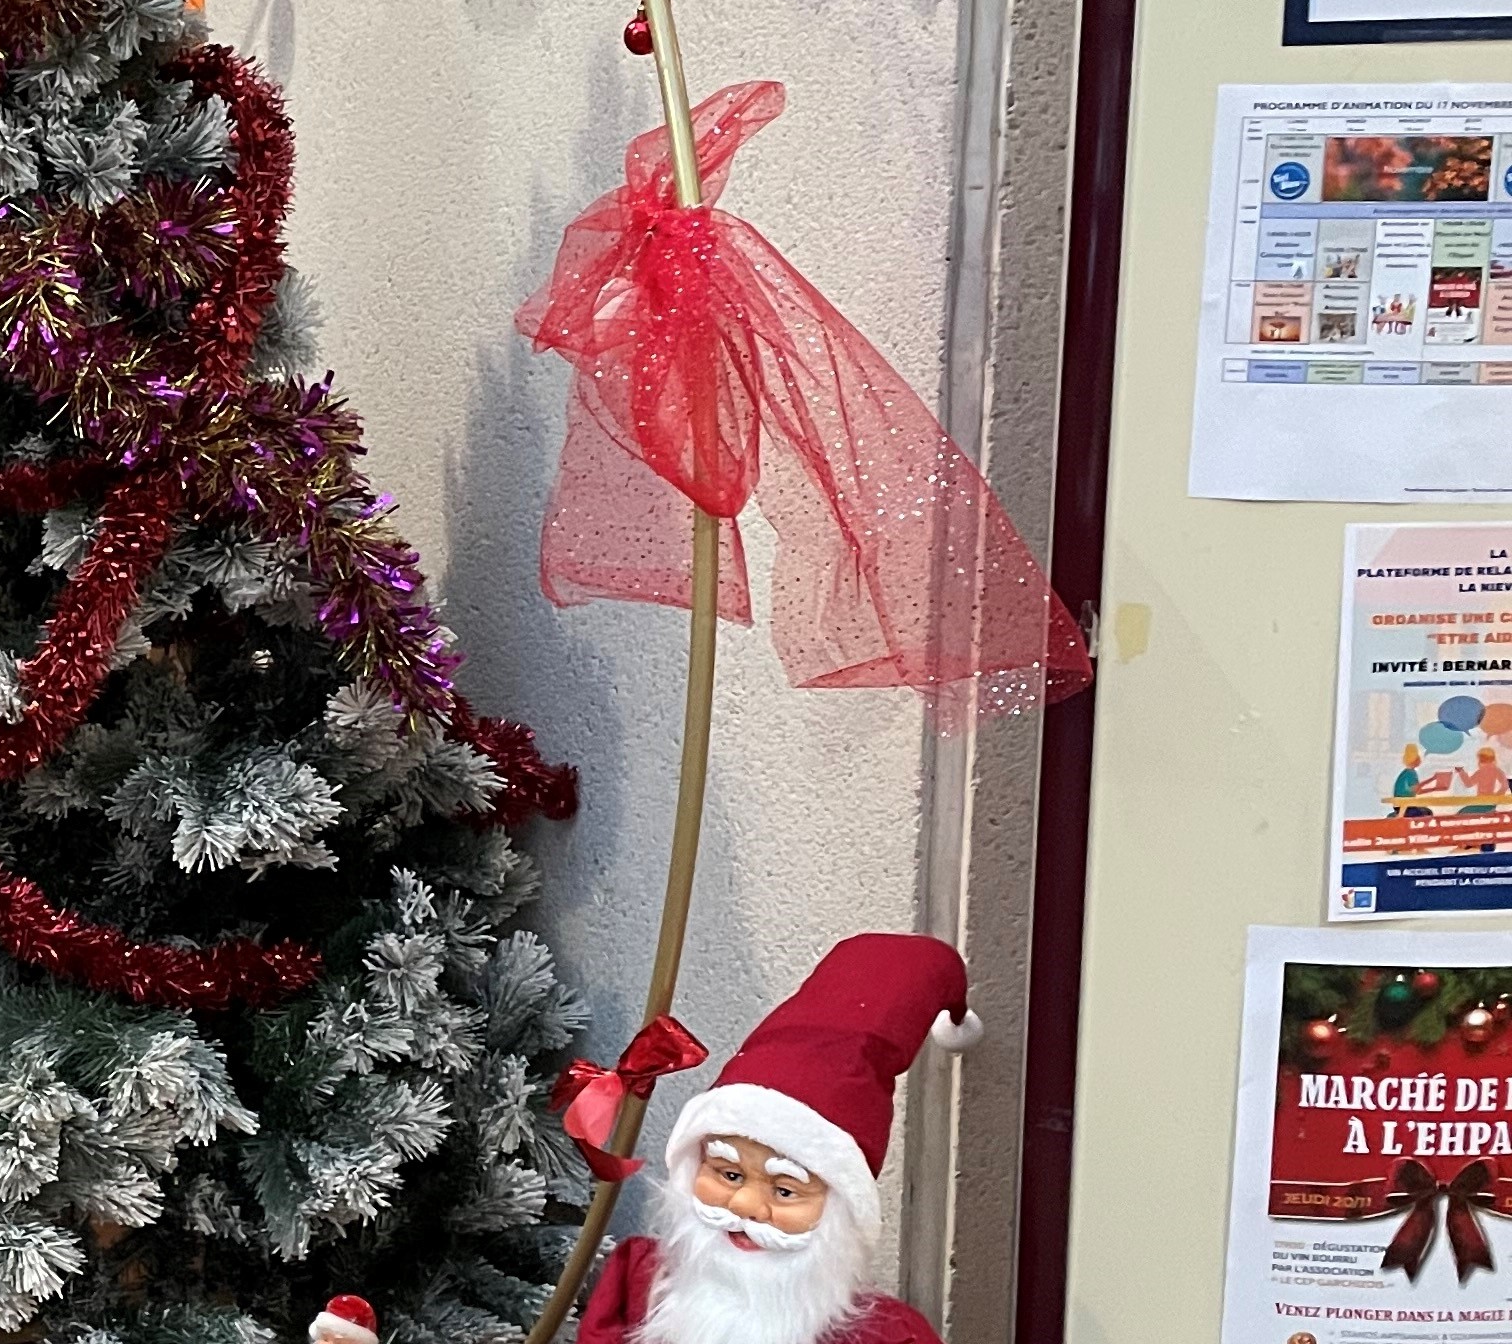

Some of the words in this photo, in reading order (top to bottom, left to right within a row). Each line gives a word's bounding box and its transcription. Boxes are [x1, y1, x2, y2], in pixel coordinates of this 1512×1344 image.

[1254, 101, 1328, 111] PROGRAMME
[1331, 100, 1412, 111] D'ANIMATION
[1415, 101, 1433, 110] DU
[1490, 549, 1508, 559] LA
[1357, 566, 1451, 578] PLATEFORME
[1454, 566, 1473, 577] DE
[1459, 583, 1477, 593] LA
[1372, 612, 1458, 626] ORGANISE
[1462, 612, 1495, 625] UNE
[1372, 657, 1428, 674] INVITÉ
[1442, 659, 1512, 673] BERNAR
[1298, 1072, 1447, 1112] MARCHÉ
[1454, 1077, 1499, 1113] DE
[1343, 1116, 1370, 1154] À
[1283, 1192, 1330, 1206] JEUDI
[1272, 1251, 1288, 1260] DU
[1291, 1252, 1310, 1261] VIN
[1312, 1254, 1358, 1264] BOURRU
[1271, 1263, 1292, 1272] PAR
[1294, 1265, 1375, 1276] L'ASSOCIATION
[1275, 1302, 1322, 1318] VENEZ
[1325, 1306, 1394, 1322] PLONGER
[1396, 1310, 1435, 1323] DANS
[1437, 1310, 1454, 1323] LA
[1458, 1309, 1505, 1322] MAGIE
